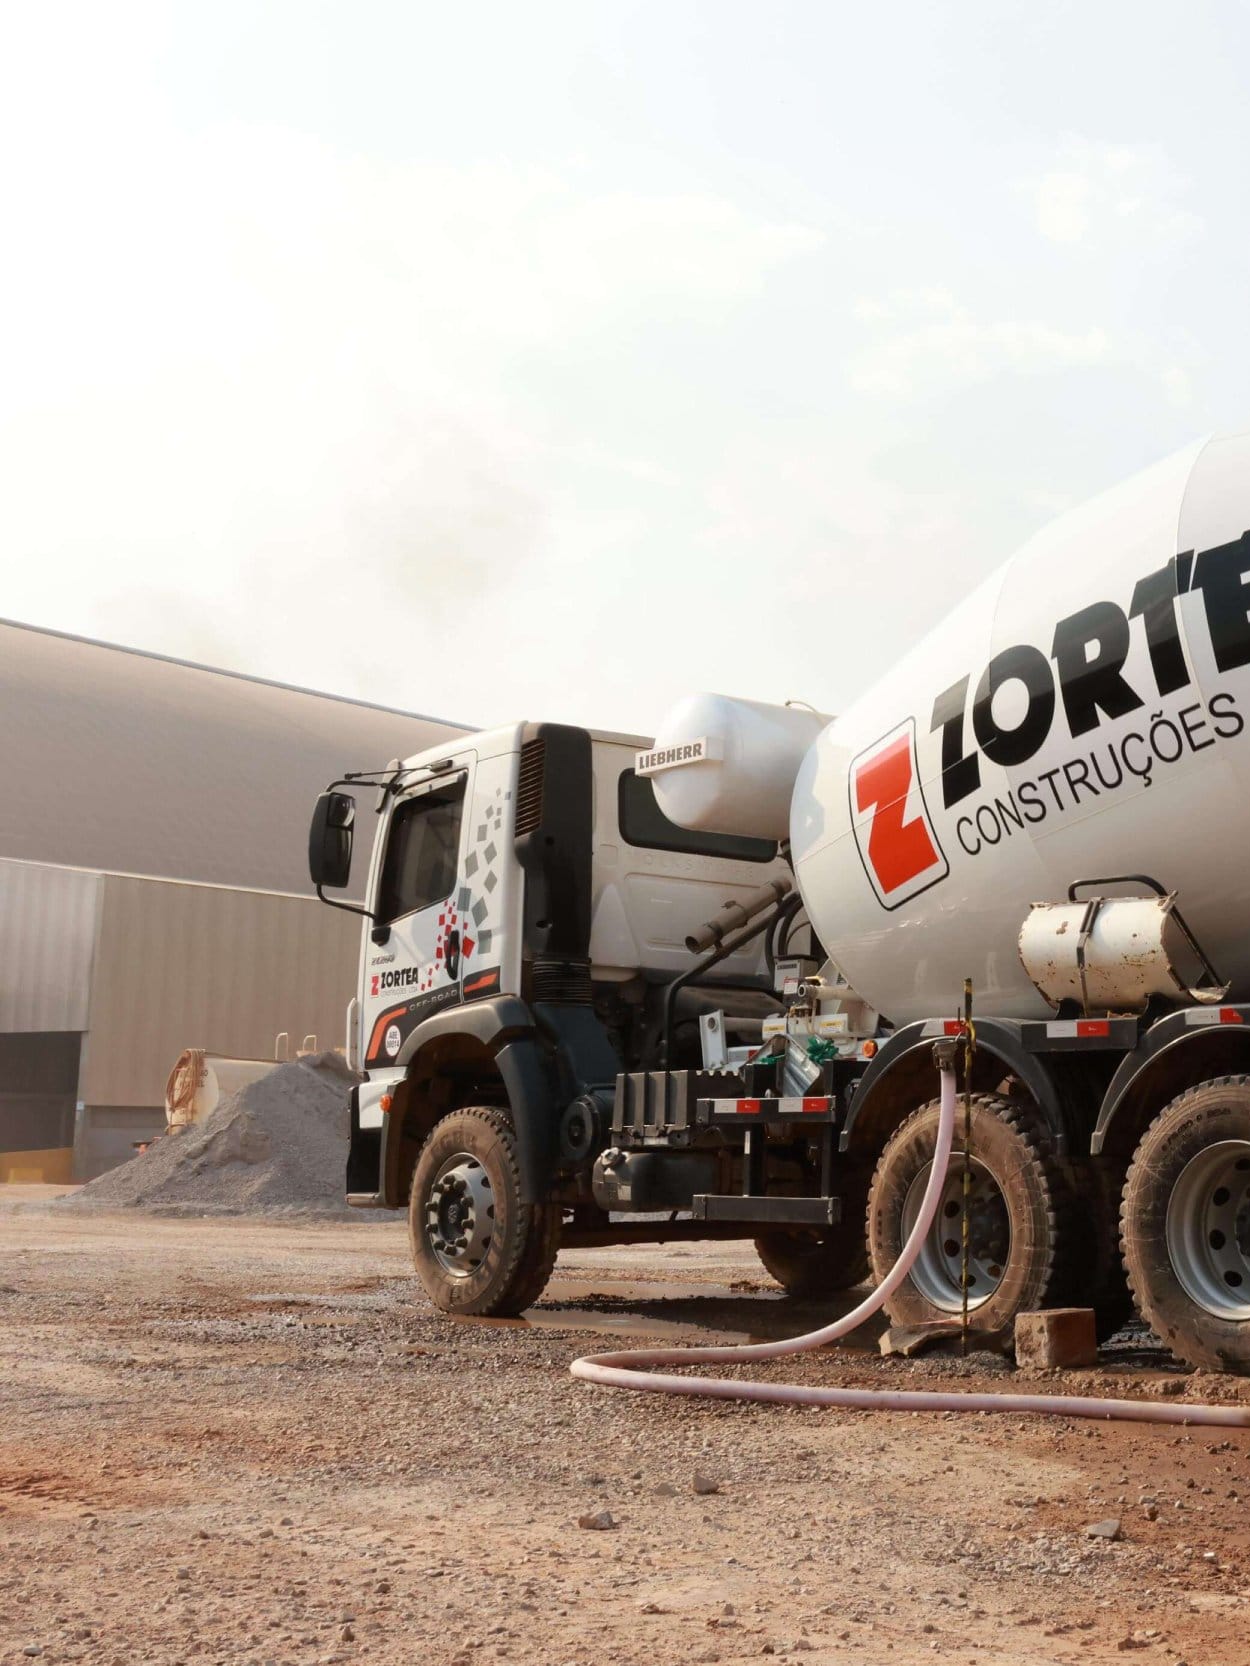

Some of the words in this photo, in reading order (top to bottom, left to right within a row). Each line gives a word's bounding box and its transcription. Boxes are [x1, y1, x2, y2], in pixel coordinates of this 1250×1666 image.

[639, 743, 702, 769] LIEBHERR
[956, 693, 1245, 856] CONSTRUÇÕES
[381, 967, 419, 989] ZORTEA
